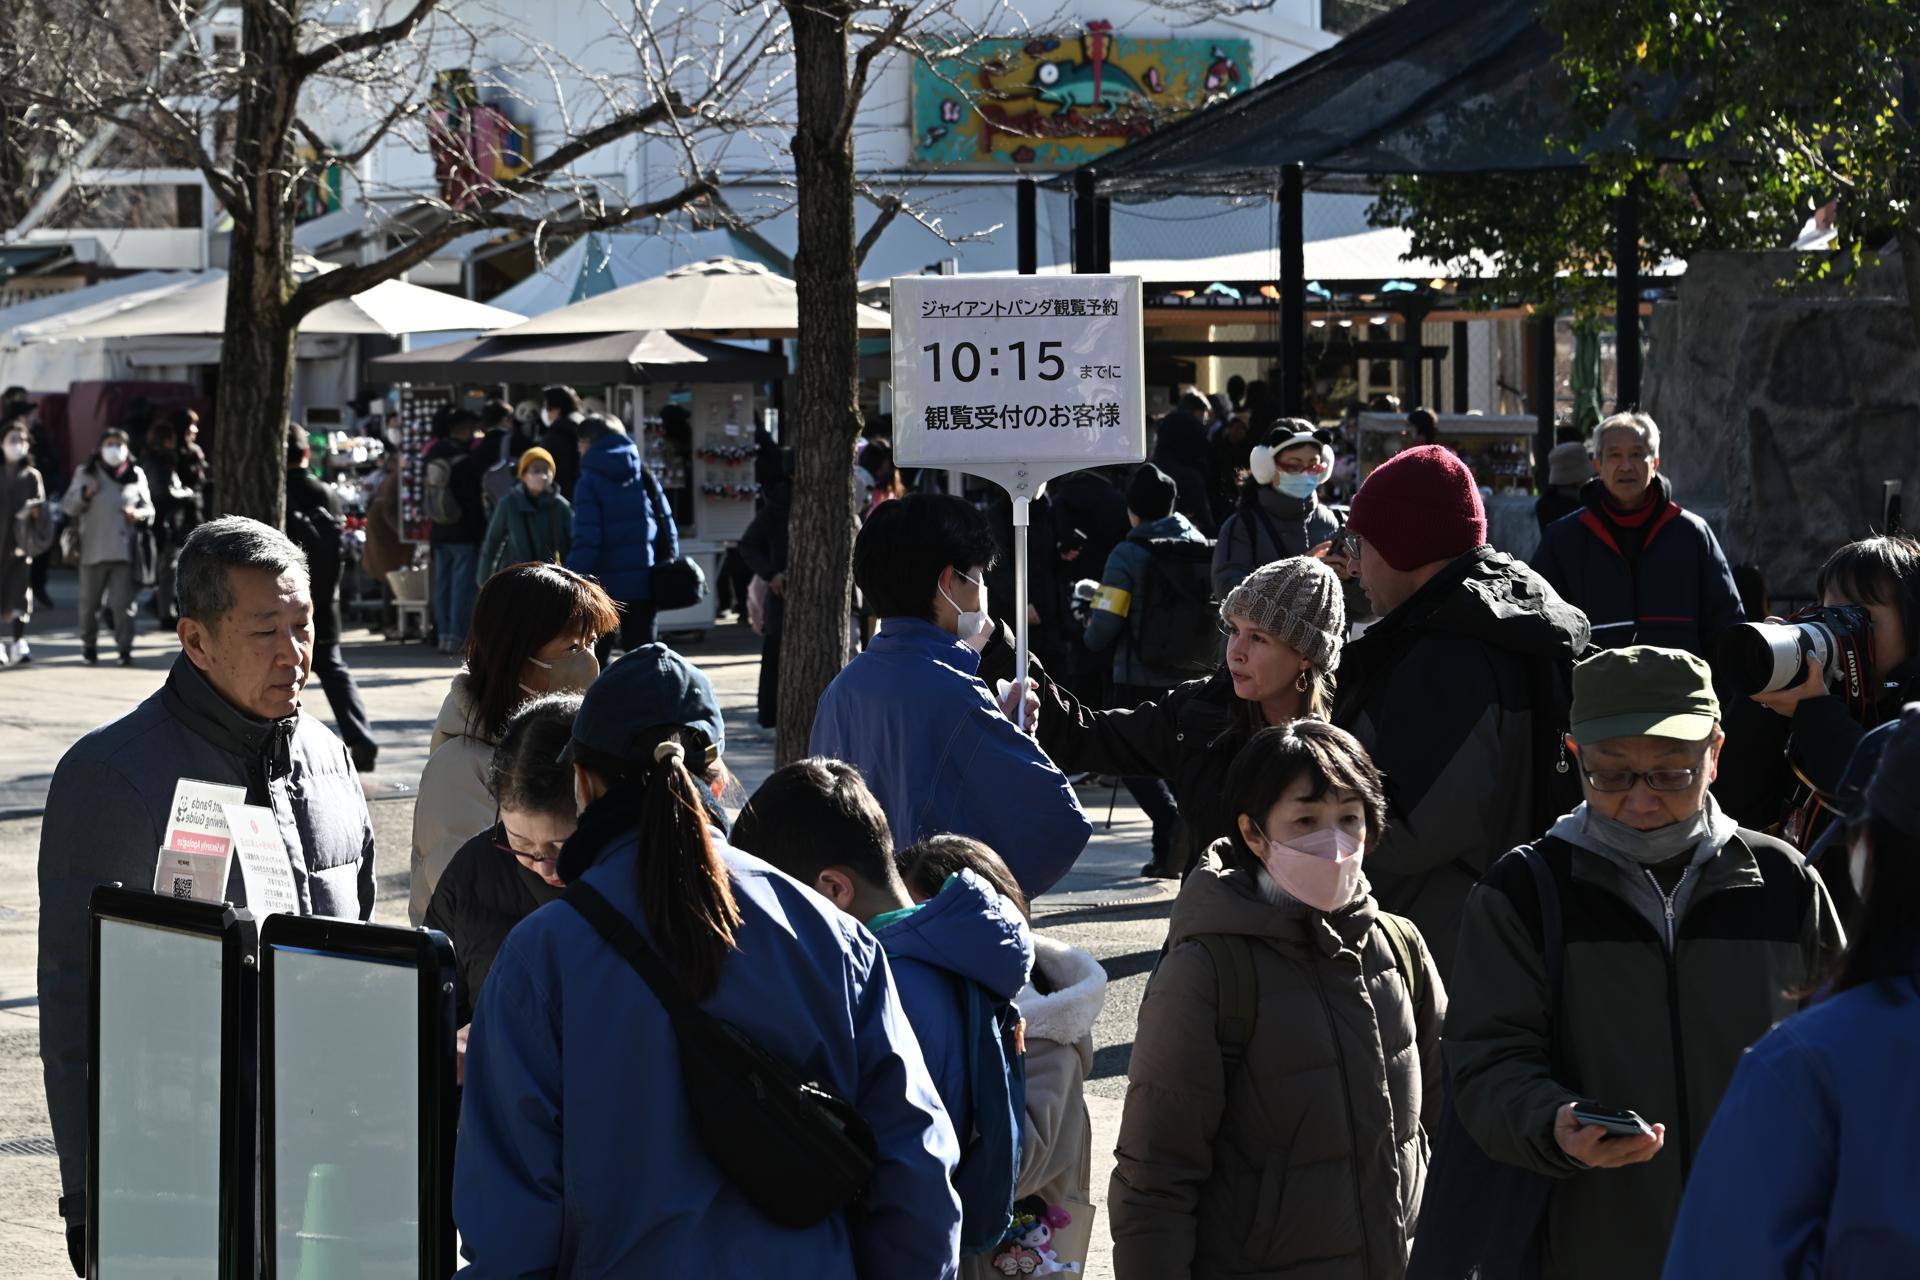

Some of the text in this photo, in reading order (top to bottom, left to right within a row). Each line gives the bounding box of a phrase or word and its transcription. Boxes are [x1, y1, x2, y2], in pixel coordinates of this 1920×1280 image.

[922, 298, 1118, 317] ジャイアントパンダ観覧予約
[923, 341, 1121, 383] 10:15 までに
[924, 402, 1120, 431] 観覧受付のお客様
[1847, 650, 1859, 697] Canon
